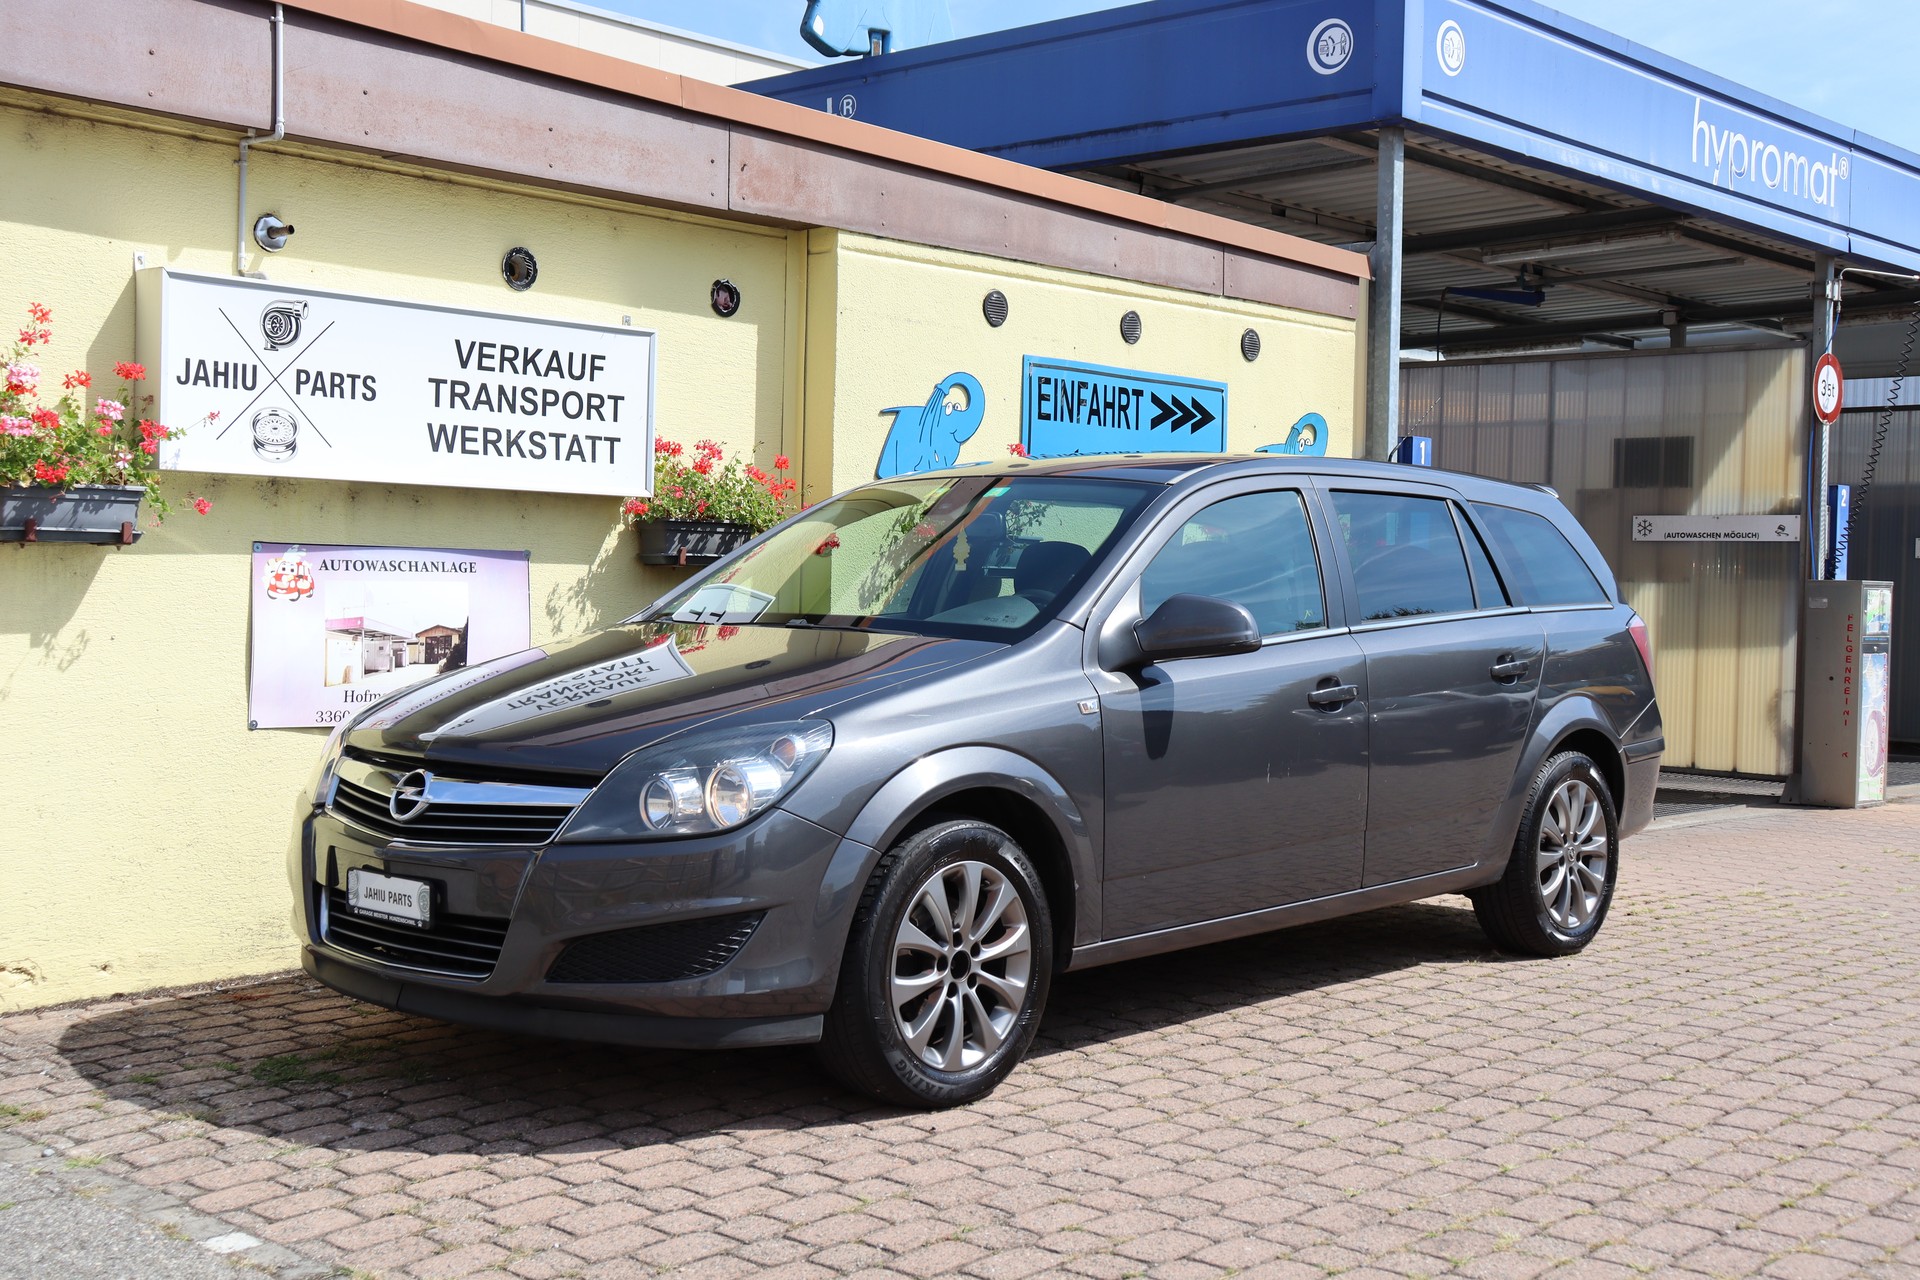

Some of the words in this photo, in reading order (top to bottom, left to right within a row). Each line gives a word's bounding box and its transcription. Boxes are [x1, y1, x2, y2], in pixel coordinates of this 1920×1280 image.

[454, 338, 607, 382] VERKAUF
[176, 357, 258, 392] JAHIU
[295, 368, 377, 402] PARTS
[427, 377, 625, 423] TRANSPORT
[1037, 376, 1145, 431] EINFAHRT
[426, 422, 622, 465] WERKSTATT
[1419, 440, 1426, 465] 1
[1840, 488, 1847, 507] 2
[1723, 531, 1760, 540] MÖGLICH)
[318, 559, 478, 574] AUTOWASCHANLAGE
[363, 886, 386, 902] JAHIU
[388, 891, 413, 908] PARTS
